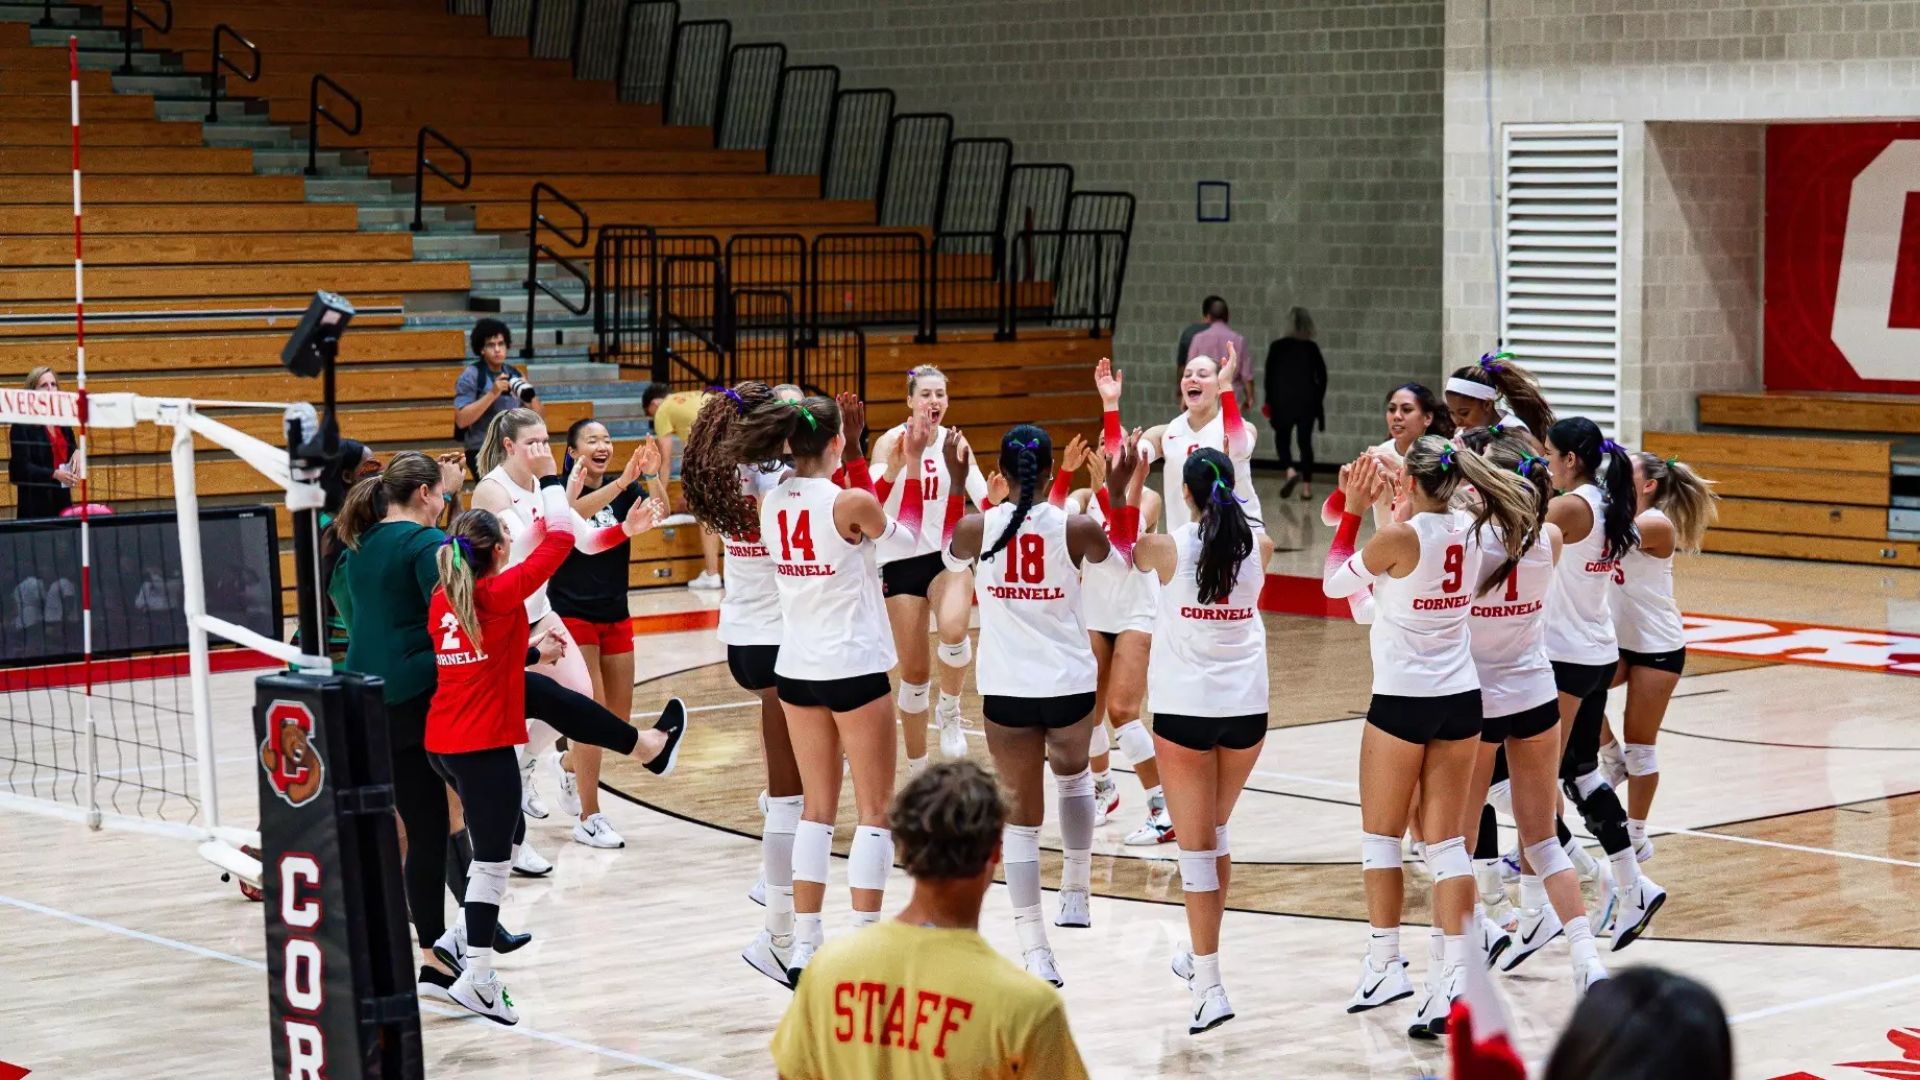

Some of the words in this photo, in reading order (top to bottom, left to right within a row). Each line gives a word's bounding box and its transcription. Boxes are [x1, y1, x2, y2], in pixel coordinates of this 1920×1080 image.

[924, 459, 936, 473] C
[924, 476, 938, 500] 11
[777, 510, 816, 561] 14
[777, 564, 836, 577] ORNELL
[1004, 533, 1045, 584] 18
[1442, 545, 1463, 593] 9
[1504, 561, 1518, 602] 1
[1181, 607, 1254, 621] CORNELL
[1471, 600, 1542, 618] CORNELL
[440, 612, 460, 650] 2
[835, 982, 973, 1058] STAFF
